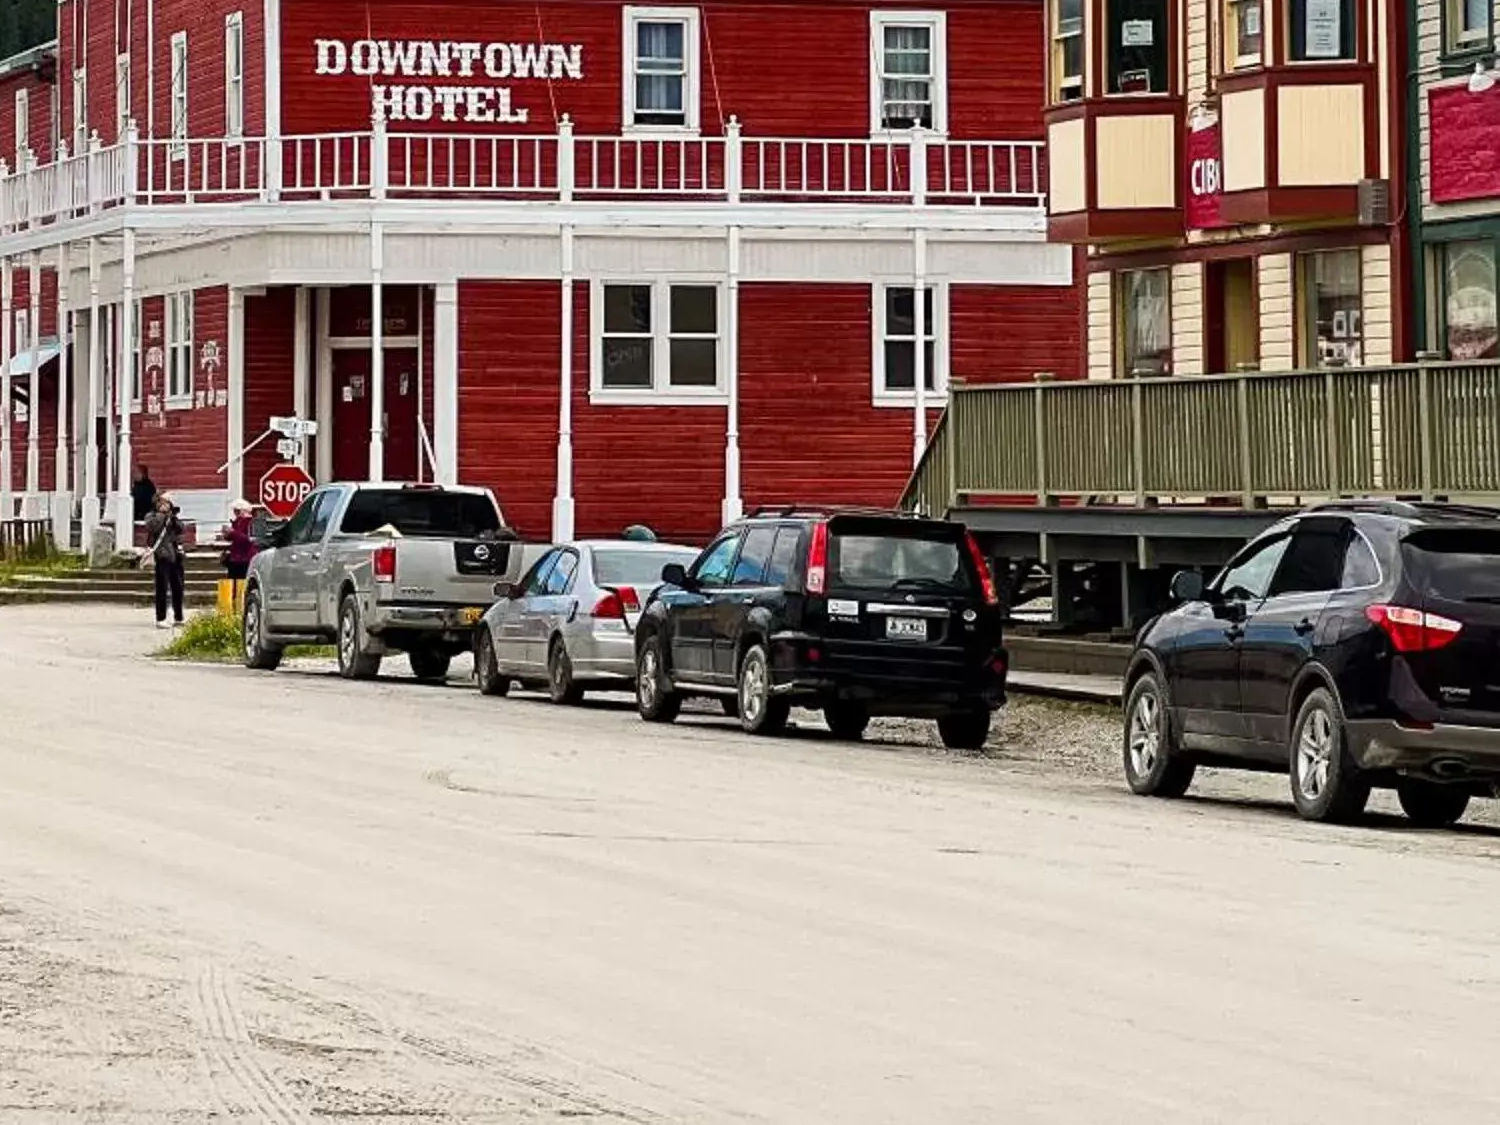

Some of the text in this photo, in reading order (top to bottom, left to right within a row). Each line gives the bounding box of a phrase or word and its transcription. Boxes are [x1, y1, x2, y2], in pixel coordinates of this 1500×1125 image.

[314, 39, 584, 79] DOWNTOWN
[371, 84, 528, 123] HOTEL
[264, 480, 311, 502] STOP
